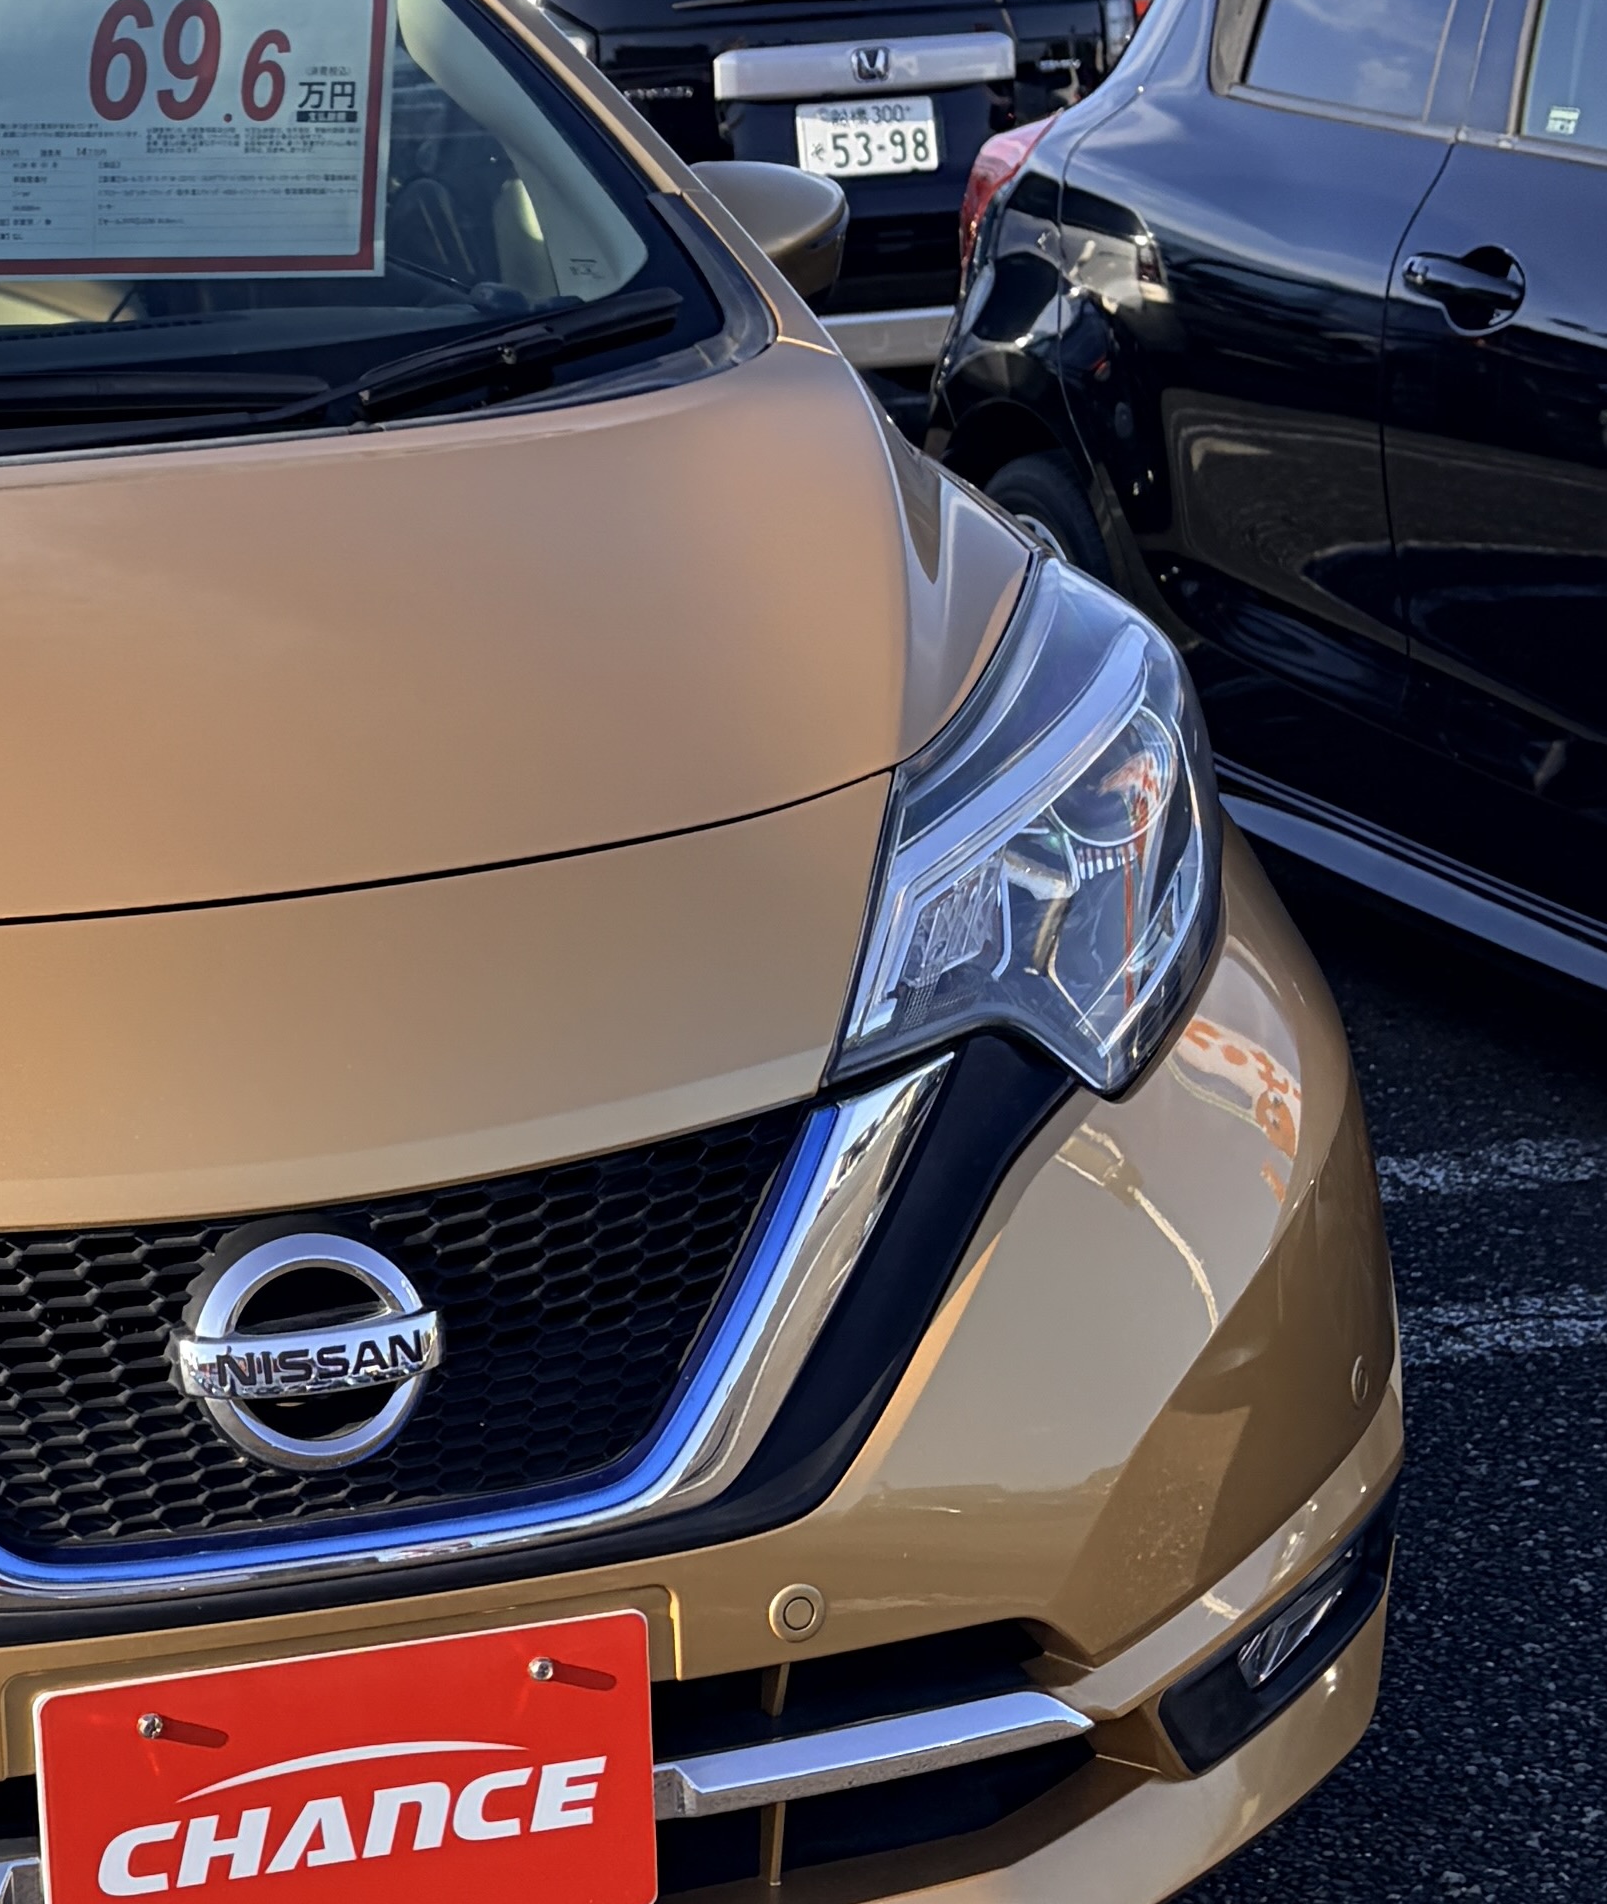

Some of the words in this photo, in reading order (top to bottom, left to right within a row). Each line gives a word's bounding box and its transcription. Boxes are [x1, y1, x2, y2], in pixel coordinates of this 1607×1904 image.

[298, 81, 357, 110] 万円
[872, 103, 905, 120] 300
[831, 127, 930, 169] 53-98
[215, 1329, 423, 1387] NISSAN
[97, 1754, 607, 1897] CHANCE
